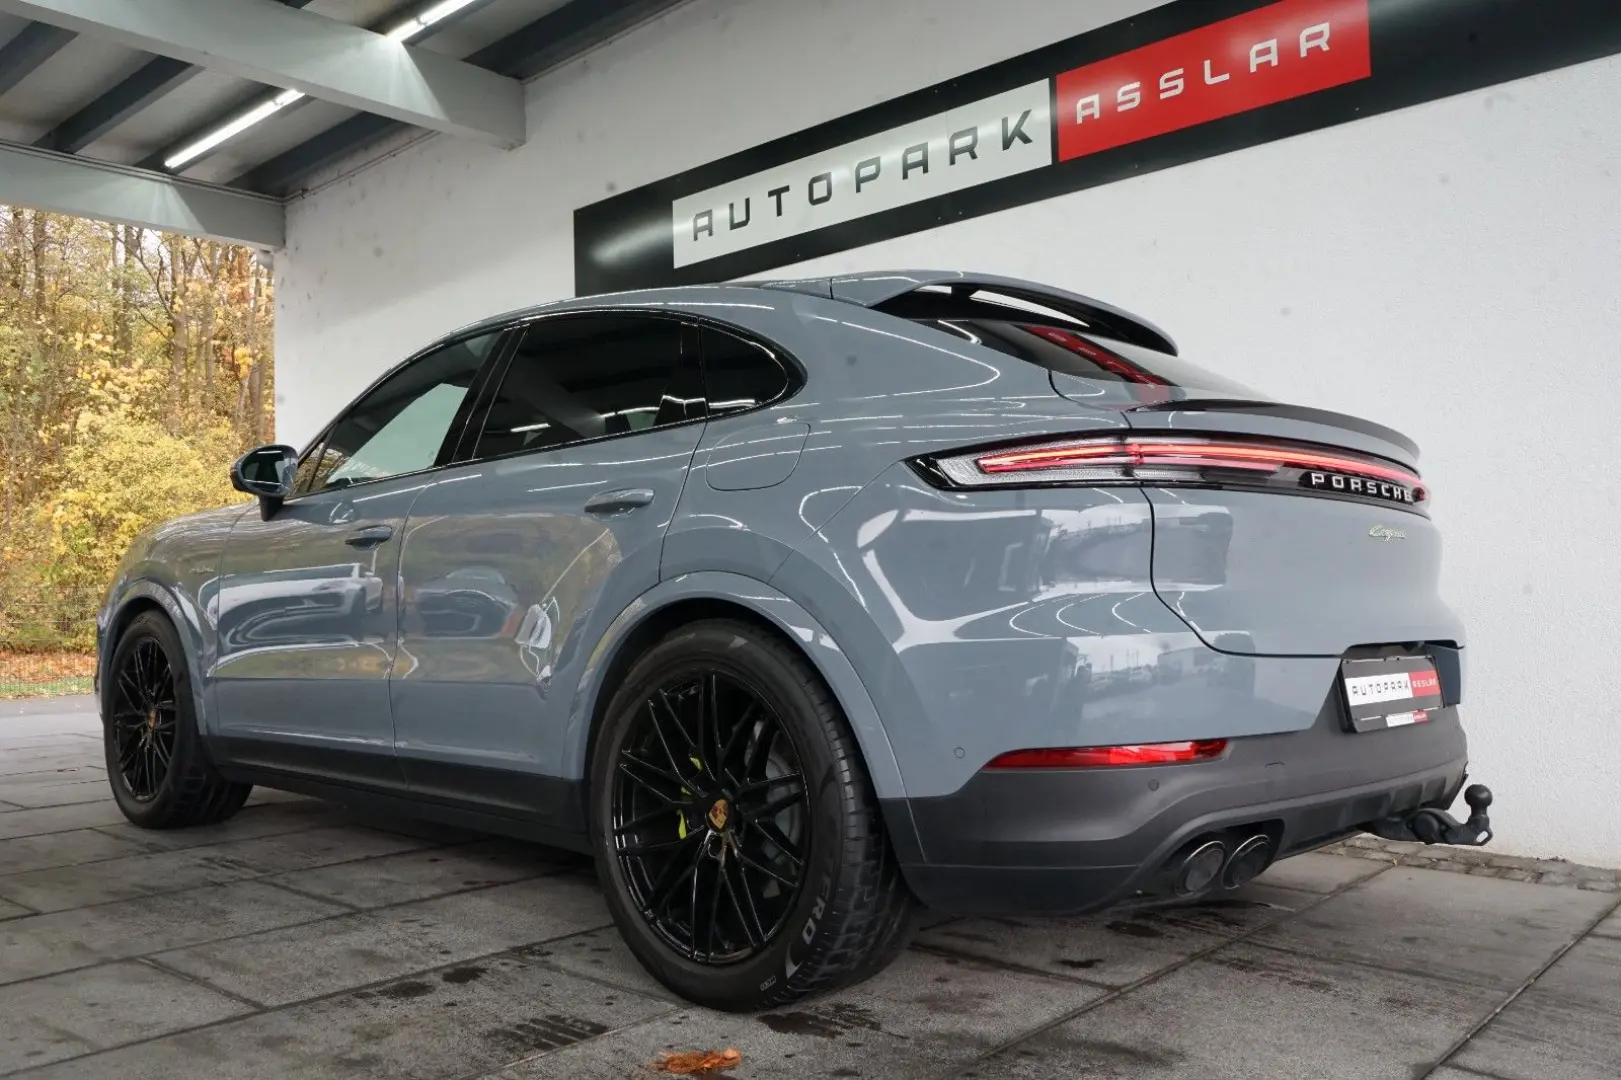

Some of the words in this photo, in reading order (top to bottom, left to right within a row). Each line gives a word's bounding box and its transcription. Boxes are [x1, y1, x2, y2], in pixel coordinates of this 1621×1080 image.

[692, 109, 1033, 241] AUTOPARK
[1075, 22, 1330, 124] ASSLAR
[1311, 472, 1413, 501] PORSCHE
[1351, 680, 1409, 696] AUTOPARK
